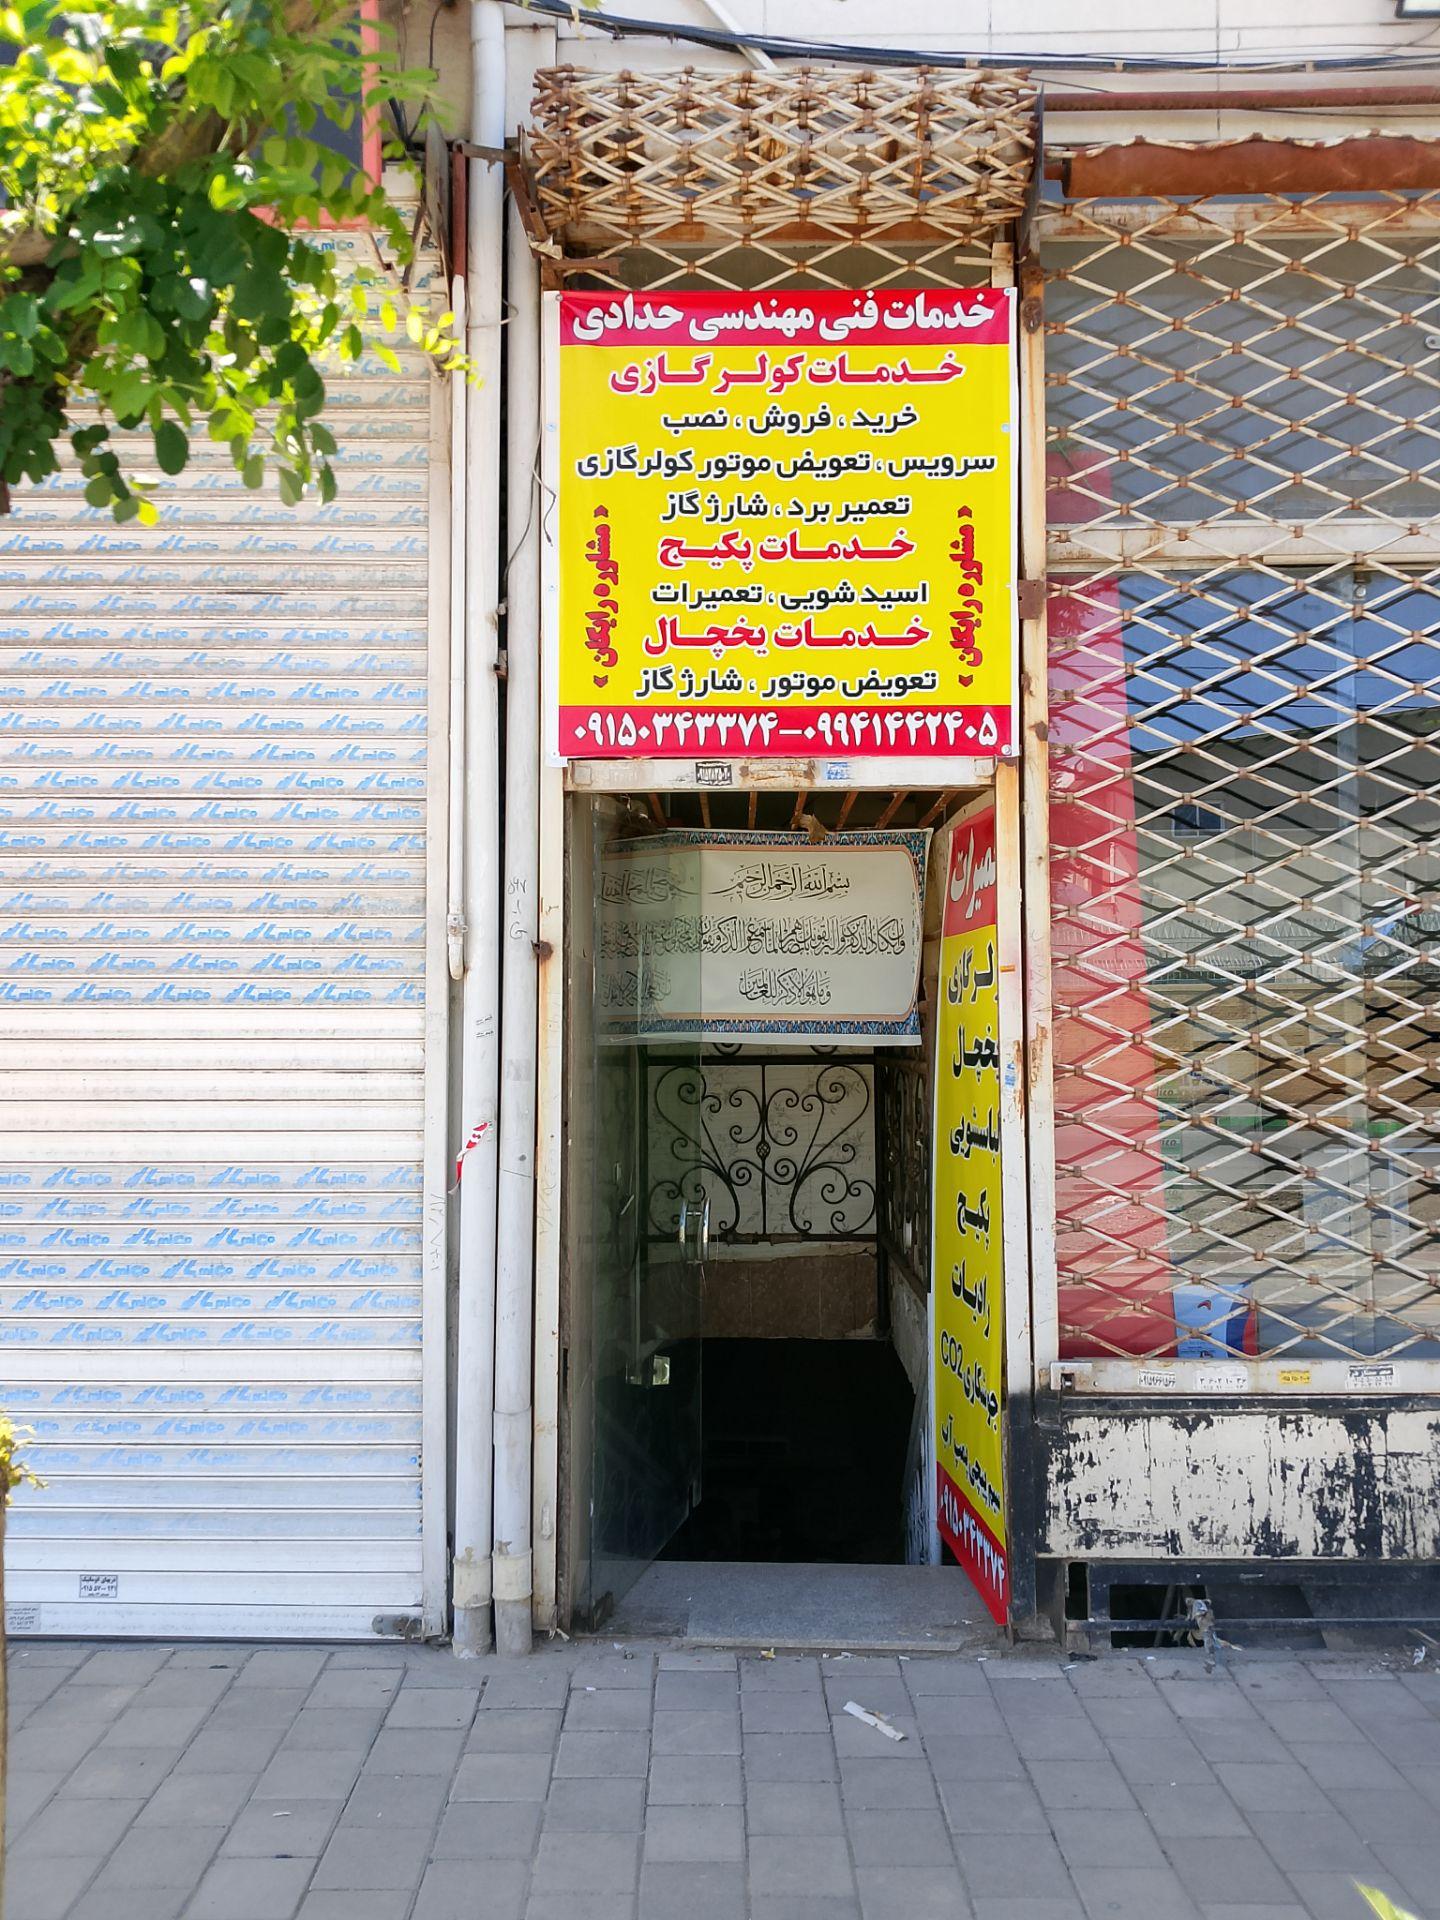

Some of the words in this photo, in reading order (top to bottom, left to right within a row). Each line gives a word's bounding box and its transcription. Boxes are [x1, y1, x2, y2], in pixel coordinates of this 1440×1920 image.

[573, 294, 684, 342] حدادی
[690, 299, 814, 342] مهندسی
[819, 291, 878, 342] فنی
[884, 294, 994, 332] خدمات
[610, 353, 711, 394] گازی
[714, 353, 805, 393] کولر
[810, 352, 964, 387] خدمات
[662, 408, 728, 434] نصب
[748, 405, 832, 434] فروش
[852, 405, 918, 433] خرید
[697, 453, 771, 480] موتور
[776, 452, 870, 478] تعویض
[888, 455, 995, 481] سرویس
[661, 492, 701, 521] گاز
[704, 493, 769, 522] شارژ
[786, 498, 831, 523] برد
[836, 493, 910, 521] تعمیر
[658, 531, 753, 571] پکیج
[757, 528, 917, 563] خدمات
[651, 582, 764, 607] تعمیرات
[778, 581, 855, 612] شویی
[862, 582, 928, 607] اسید
[584, 599, 620, 668] رایگان
[644, 614, 768, 659] یخچال
[772, 614, 931, 652] خدمات
[949, 599, 984, 668] رایگان
[636, 665, 674, 697] گاز
[679, 669, 743, 697] شارژ
[761, 671, 836, 698] موتور
[840, 668, 938, 696] تعویض
[957, 1187, 991, 1252] پکیج
[940, 1330, 965, 1381] CO2
